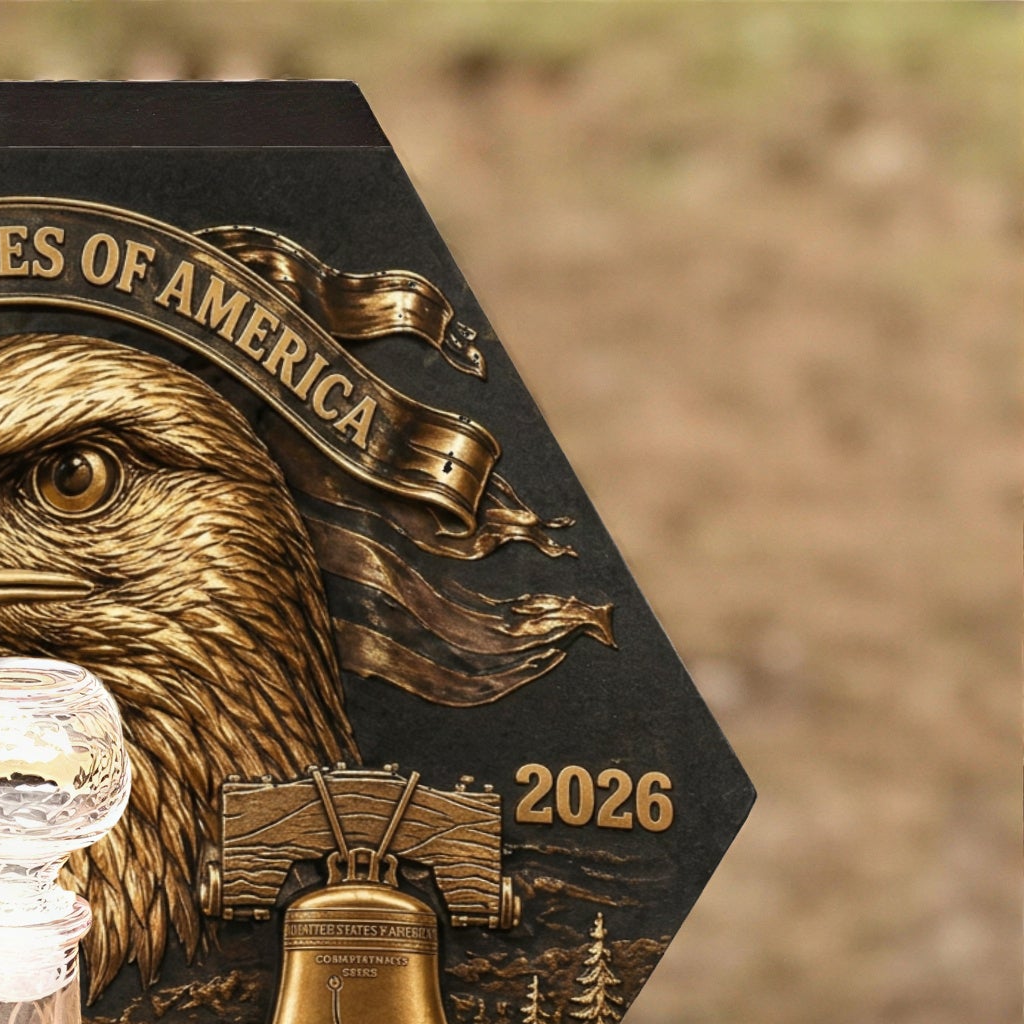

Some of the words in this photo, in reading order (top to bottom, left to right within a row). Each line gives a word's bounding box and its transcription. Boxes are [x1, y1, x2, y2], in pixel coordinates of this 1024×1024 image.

[80, 231, 158, 292] OF
[154, 261, 378, 451] AMERICA
[515, 763, 673, 832] 2026
